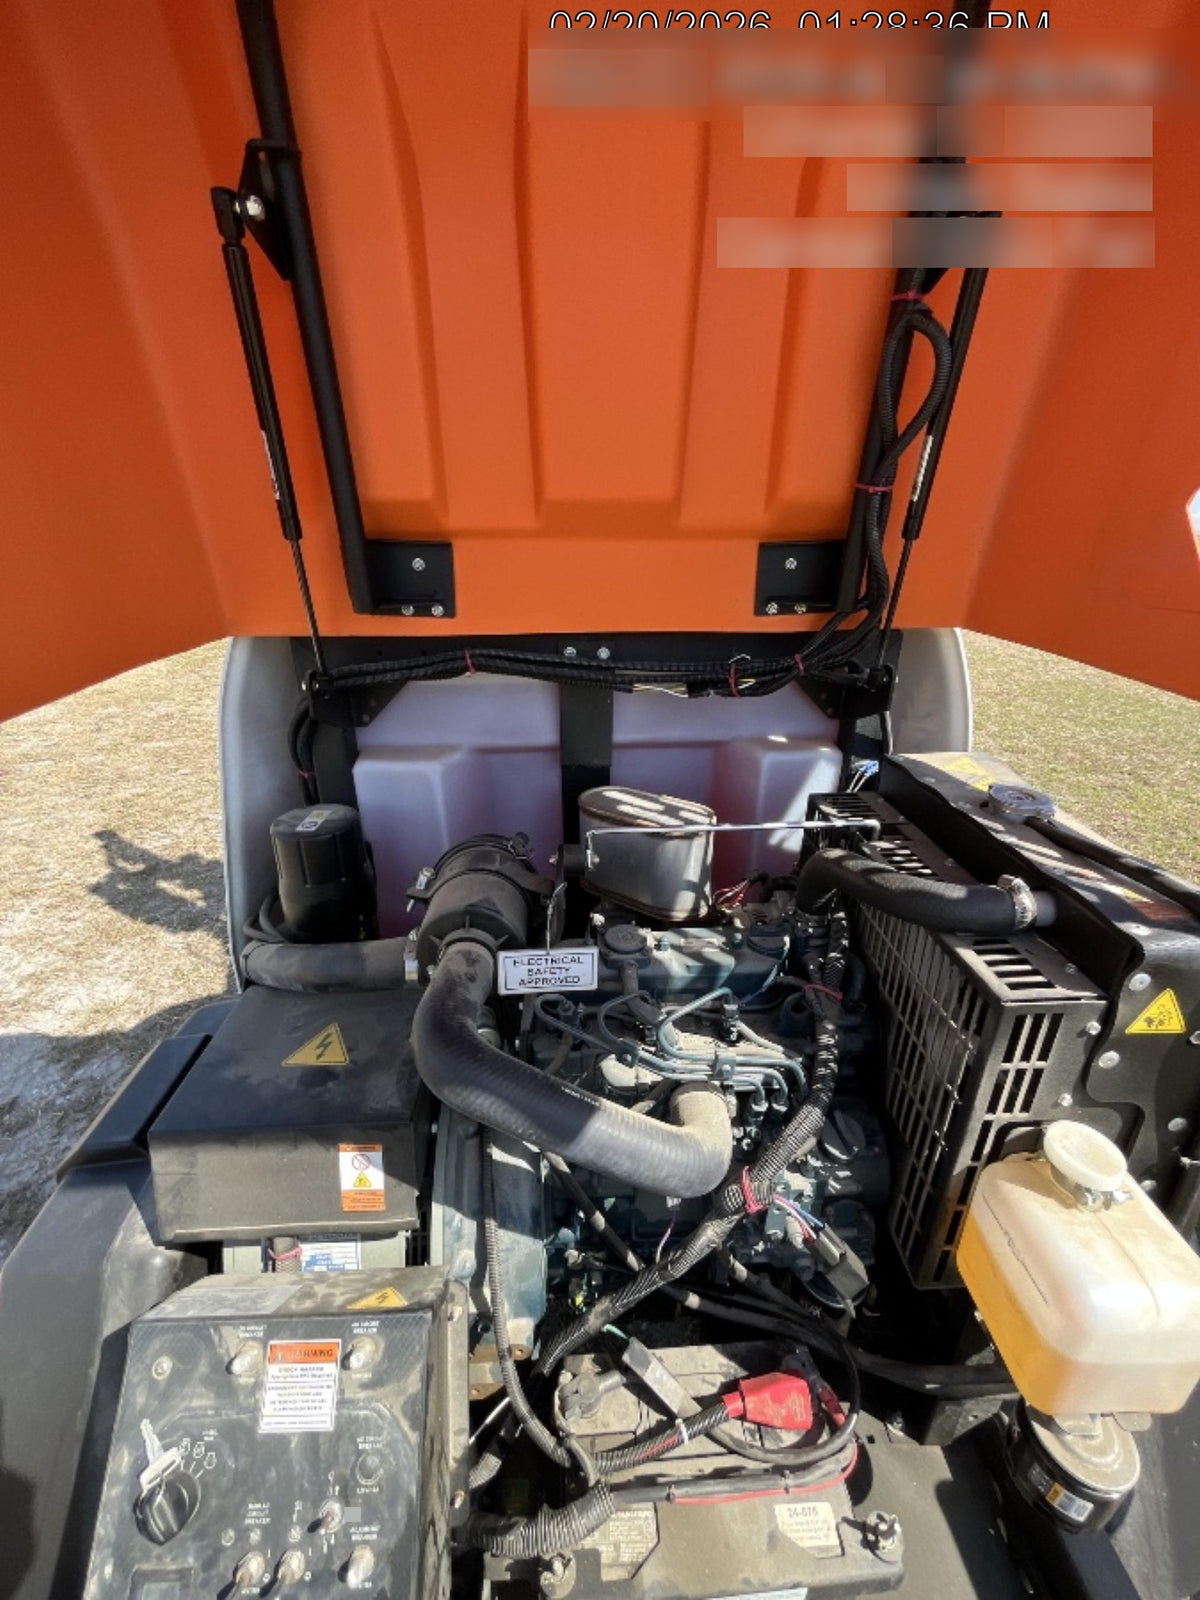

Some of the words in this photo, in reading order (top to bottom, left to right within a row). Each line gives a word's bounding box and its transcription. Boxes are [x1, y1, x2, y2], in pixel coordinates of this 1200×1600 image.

[513, 956, 584, 967] ELECTRICAL
[527, 966, 571, 977] SAFETY
[518, 975, 581, 986] APPROVED
